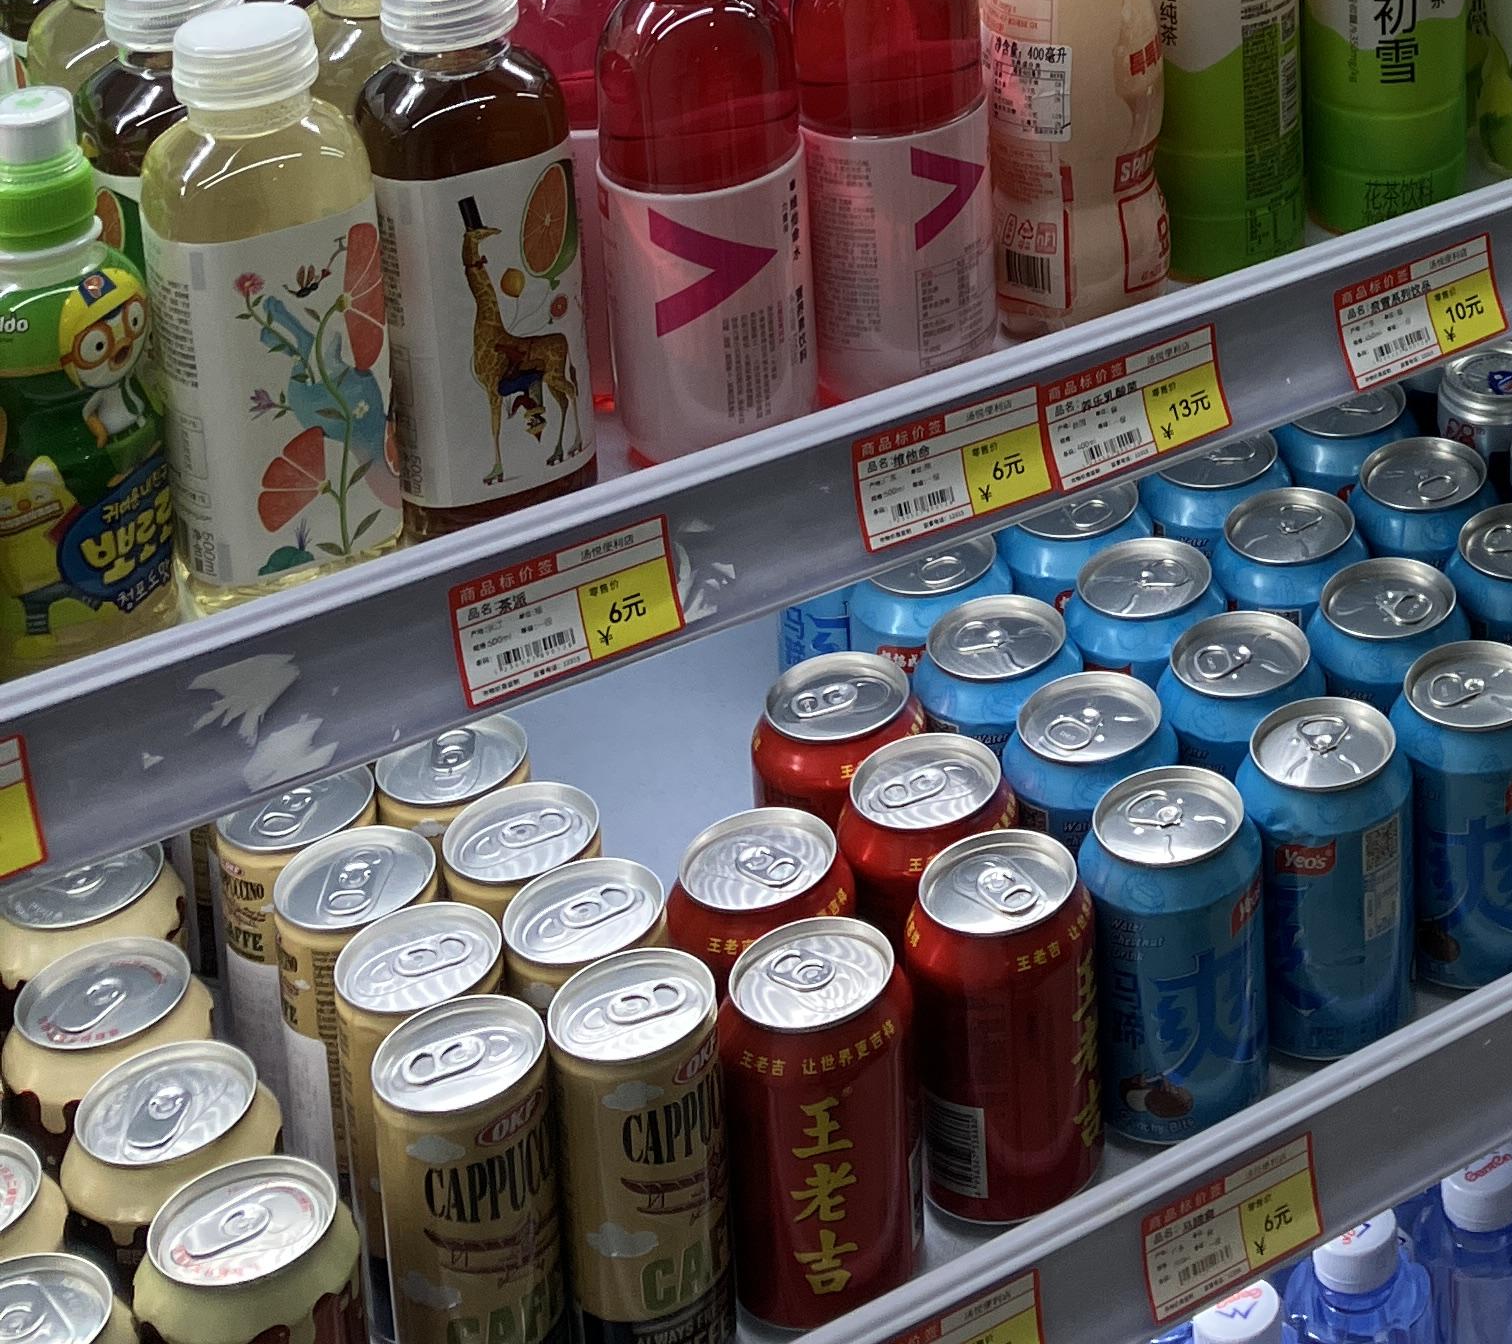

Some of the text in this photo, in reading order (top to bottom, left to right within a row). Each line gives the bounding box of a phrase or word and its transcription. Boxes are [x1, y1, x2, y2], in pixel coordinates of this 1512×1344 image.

[1446, 294, 1485, 323] 10元
[1047, 364, 1125, 401] 商品标价签
[1168, 390, 1212, 422] 13元
[861, 419, 942, 457] 商品标价签
[992, 453, 1025, 481] 6元
[460, 561, 553, 603] 商品标价签
[608, 594, 647, 625] 6元
[1016, 939, 1062, 972] 王老吉
[740, 1017, 896, 1077] 王老吉 让世界更吉祥
[791, 1097, 856, 1296] 王老吉
[1263, 1205, 1293, 1232] 6元
